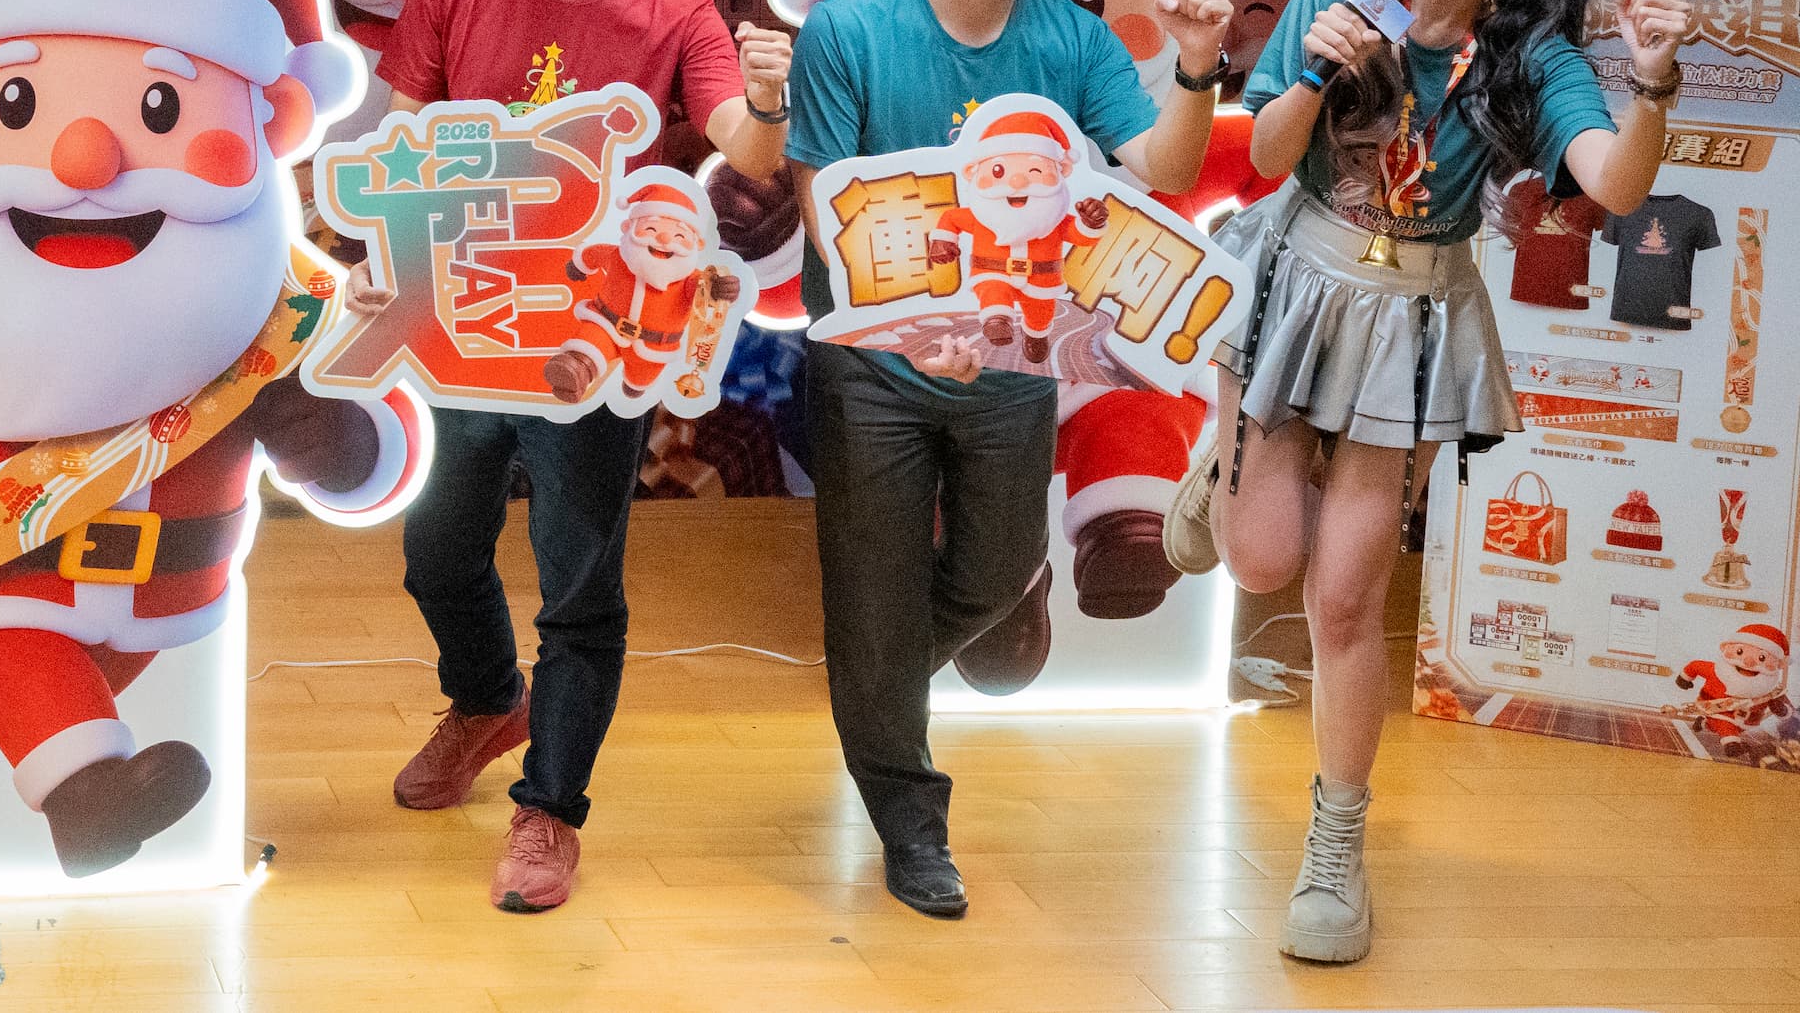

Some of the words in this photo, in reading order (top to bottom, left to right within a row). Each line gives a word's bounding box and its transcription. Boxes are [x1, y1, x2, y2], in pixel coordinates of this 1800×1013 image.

[1679, 87, 1738, 100] HRISTMAS
[1738, 91, 1776, 103] RELAY
[435, 122, 490, 141] 2026
[1663, 132, 1749, 166] 賽組
[1565, 412, 1627, 423] CHRISTMAS
[1631, 409, 1666, 419] RELAY
